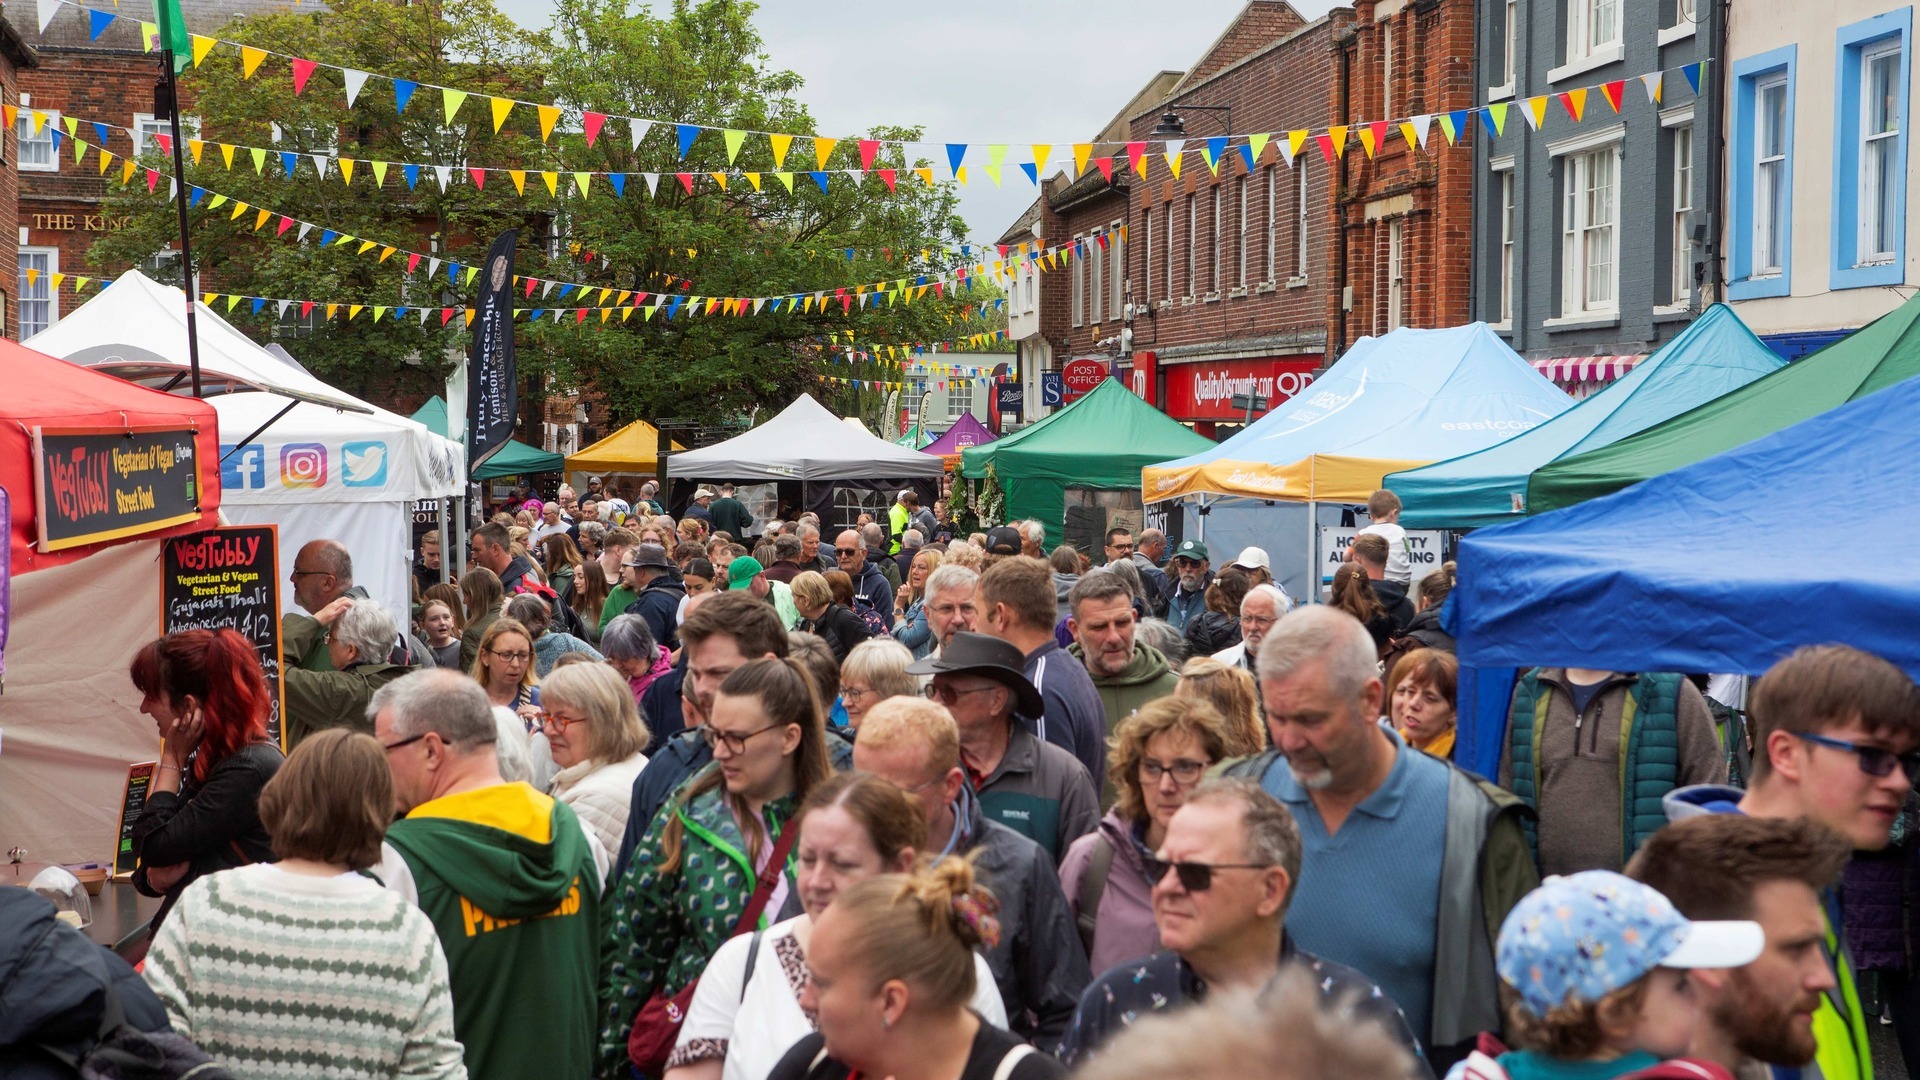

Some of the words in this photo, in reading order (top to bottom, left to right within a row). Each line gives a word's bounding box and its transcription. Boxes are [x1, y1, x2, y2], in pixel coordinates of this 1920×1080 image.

[32, 213, 76, 230] THE
[489, 355, 496, 366] &
[495, 342, 507, 390] SAUSAGE
[1073, 366, 1097, 375] POST
[1067, 375, 1101, 385] OFFICE
[1133, 369, 1146, 400] QD
[1277, 372, 1314, 398] QD
[488, 369, 502, 427] Venison
[500, 392, 507, 400] &
[1000, 390, 1023, 403] Boots
[1045, 381, 1060, 403] S
[501, 401, 510, 422] PIES
[1441, 419, 1537, 430] eastcoa
[112, 447, 149, 479] Vegetarian
[150, 445, 155, 470] &
[156, 445, 174, 474] Vegan
[49, 447, 109, 522] VegTubby
[116, 488, 138, 515] Street
[138, 485, 155, 511] Food
[411, 500, 450, 513] ame
[174, 535, 260, 571] VegTubby
[177, 573, 220, 587] Vegetarian
[222, 572, 230, 582] &
[231, 571, 259, 584] Vegan
[192, 586, 219, 597] Street
[220, 583, 242, 595] Food
[169, 595, 225, 618] Gujarati
[225, 586, 267, 609] Thali
